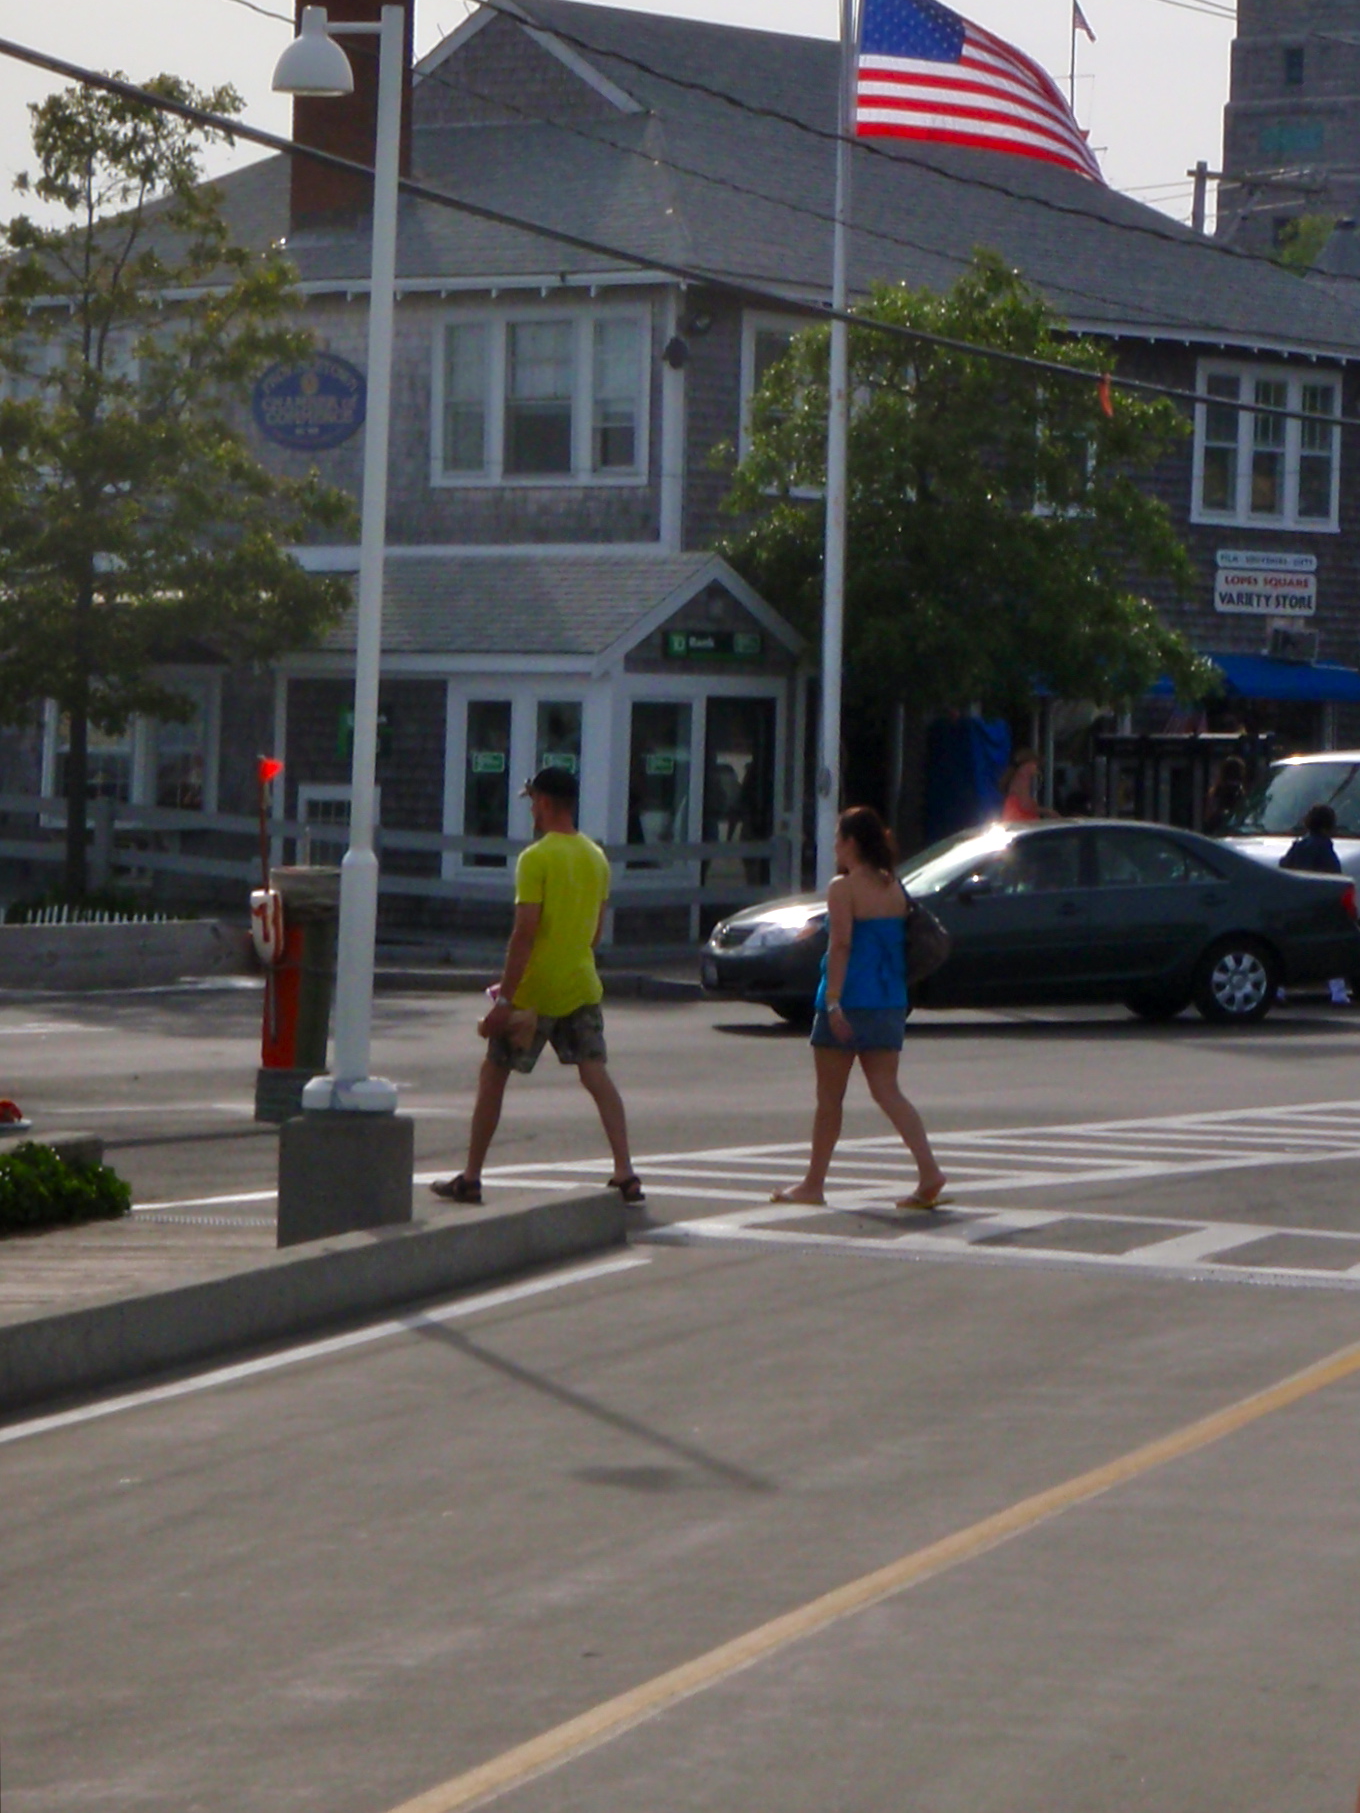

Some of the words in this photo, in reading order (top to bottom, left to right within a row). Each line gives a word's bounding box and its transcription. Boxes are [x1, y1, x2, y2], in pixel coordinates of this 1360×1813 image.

[1263, 577, 1309, 589] SQUARE
[1218, 592, 1272, 607] VARIETY
[1274, 594, 1313, 610] STORE
